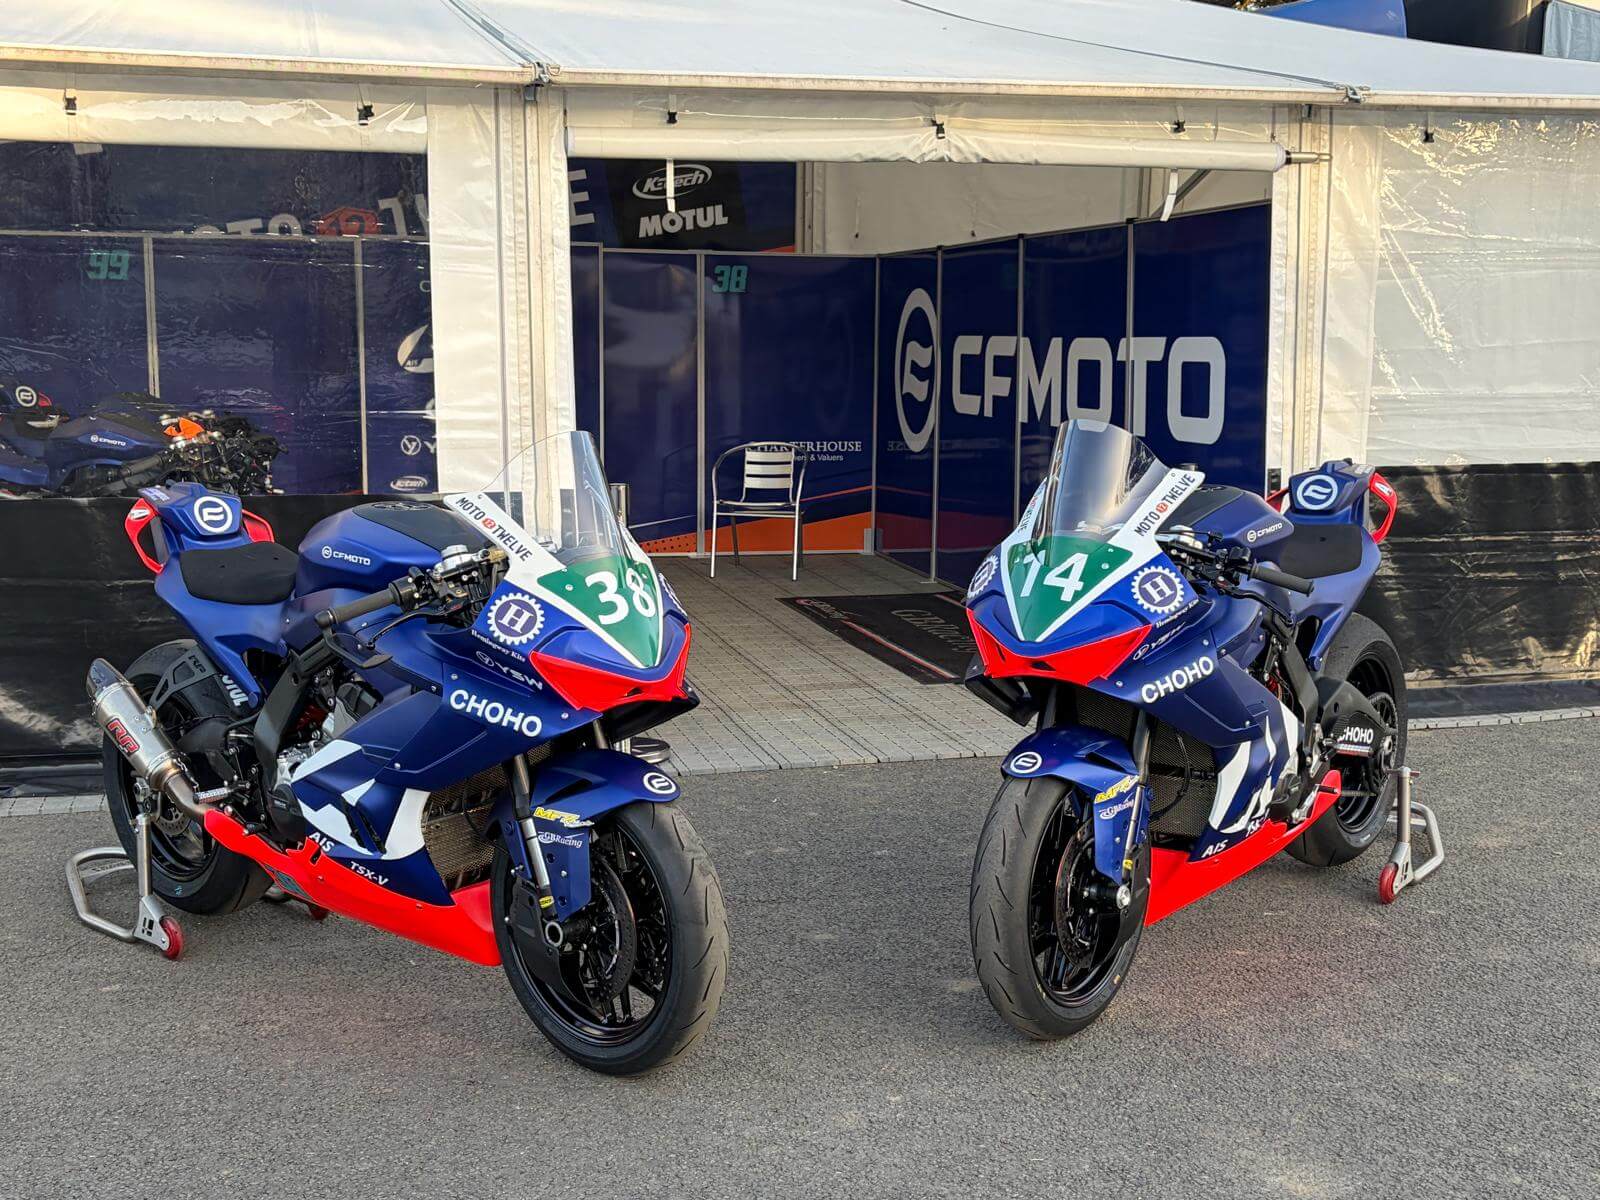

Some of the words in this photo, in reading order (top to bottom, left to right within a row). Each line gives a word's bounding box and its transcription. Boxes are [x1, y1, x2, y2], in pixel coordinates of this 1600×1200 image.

[639, 204, 729, 238] MOTUL
[87, 250, 129, 280] 99
[712, 265, 748, 293] 38
[952, 335, 1226, 445] CFMOTO
[817, 453, 844, 461] Valuers
[1134, 511, 1161, 537] MOTO
[1161, 473, 1195, 505] TWELVE
[456, 497, 486, 521] MOTO
[492, 524, 533, 561] TWELVE
[1257, 522, 1282, 537] CFMOTO
[333, 551, 371, 566] CFMOTO
[1020, 551, 1088, 602] 14
[585, 567, 656, 625] 38
[471, 629, 510, 655] Hemingway
[495, 661, 543, 690] YSW
[1141, 655, 1215, 704] CHOHO
[450, 689, 543, 738] CHOHO
[309, 831, 335, 852] AIS
[538, 831, 584, 849] GBRacing
[1201, 840, 1228, 858] AIS
[350, 861, 390, 886] TSX-V
